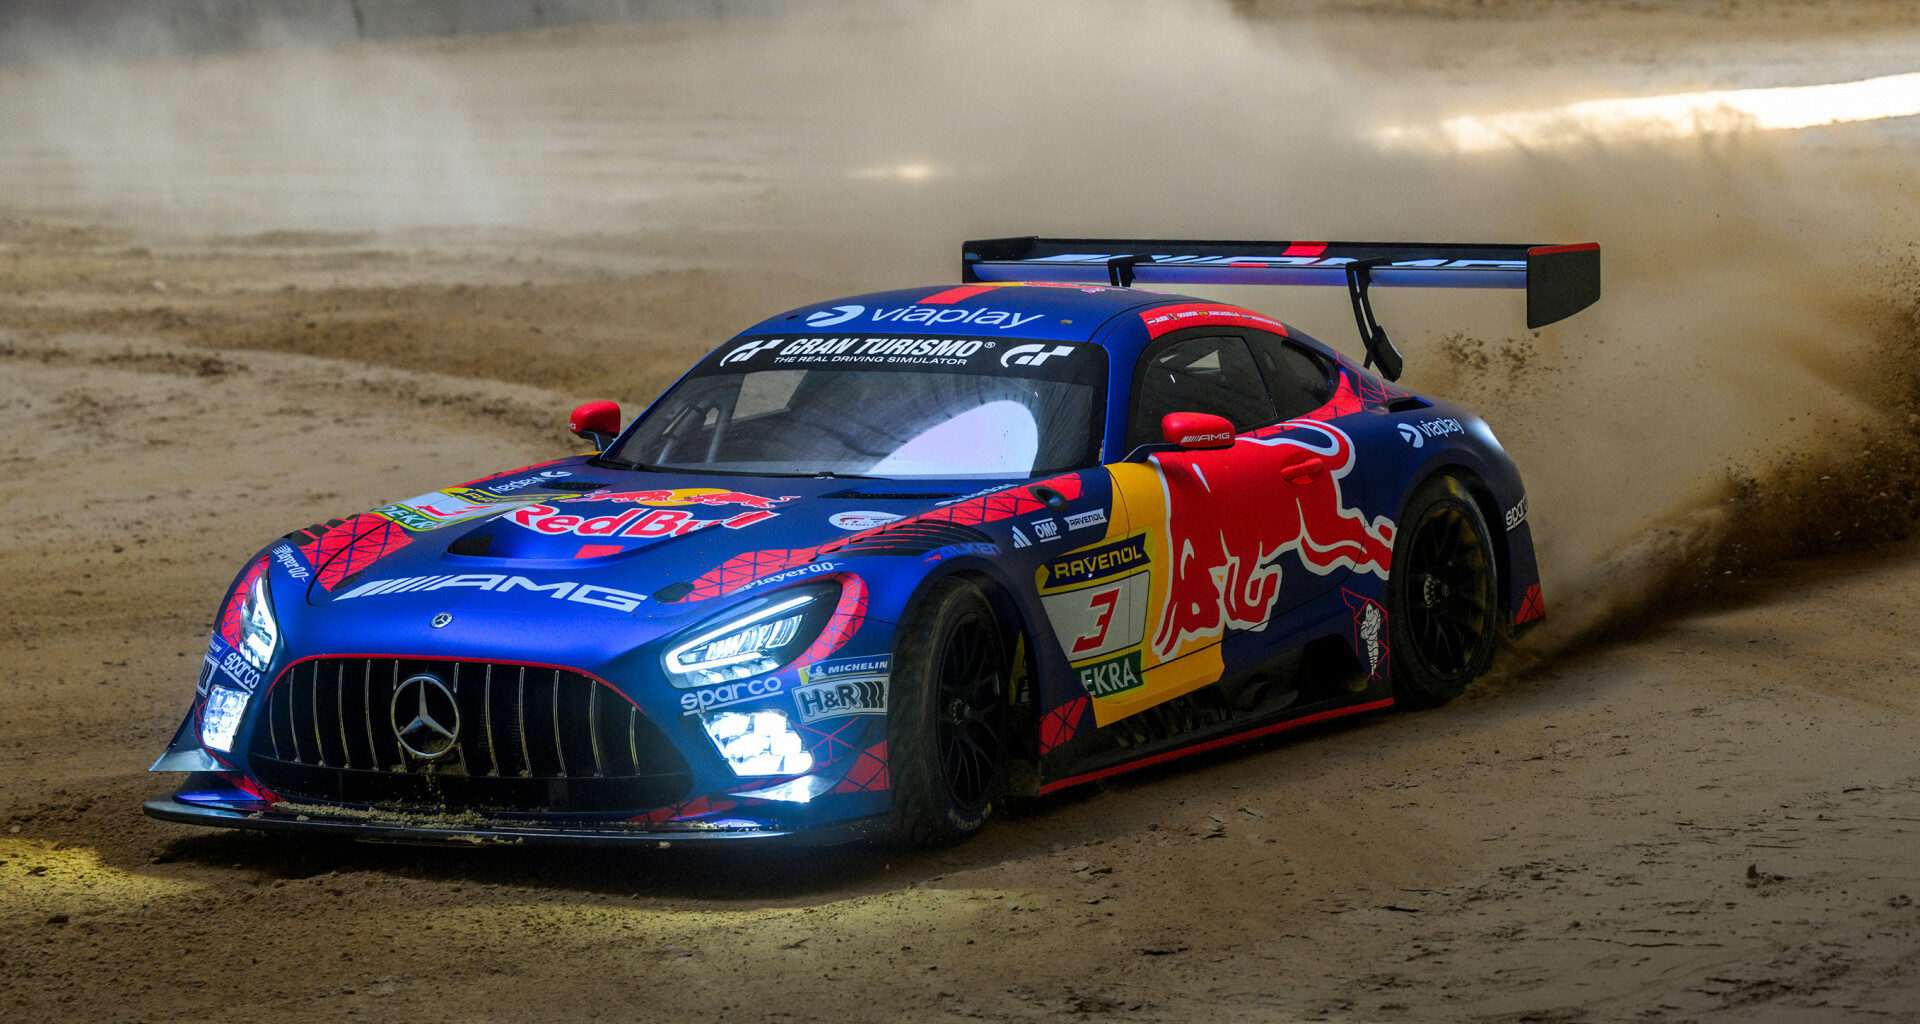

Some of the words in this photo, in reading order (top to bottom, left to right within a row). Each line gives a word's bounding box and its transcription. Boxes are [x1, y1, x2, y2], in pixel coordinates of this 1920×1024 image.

[872, 305, 1045, 329] viaplay
[774, 356, 797, 364] THE
[831, 355, 885, 363] DRIVING
[887, 356, 968, 366] SIMULATOR
[779, 338, 860, 356] GRAN
[1198, 432, 1231, 442] AMG
[1417, 417, 1465, 438] viaplay
[506, 504, 645, 536] Red
[1034, 520, 1058, 539] OMP
[1068, 513, 1104, 527] RAVENOL
[1054, 545, 1143, 579] RAVENOL
[422, 574, 649, 613] AMG
[1071, 588, 1120, 653] 3
[223, 652, 261, 689] sparco
[828, 660, 888, 674] MICHELIN
[1080, 657, 1139, 696] EKRA
[680, 676, 782, 713] sparco
[799, 684, 859, 718] H&R
